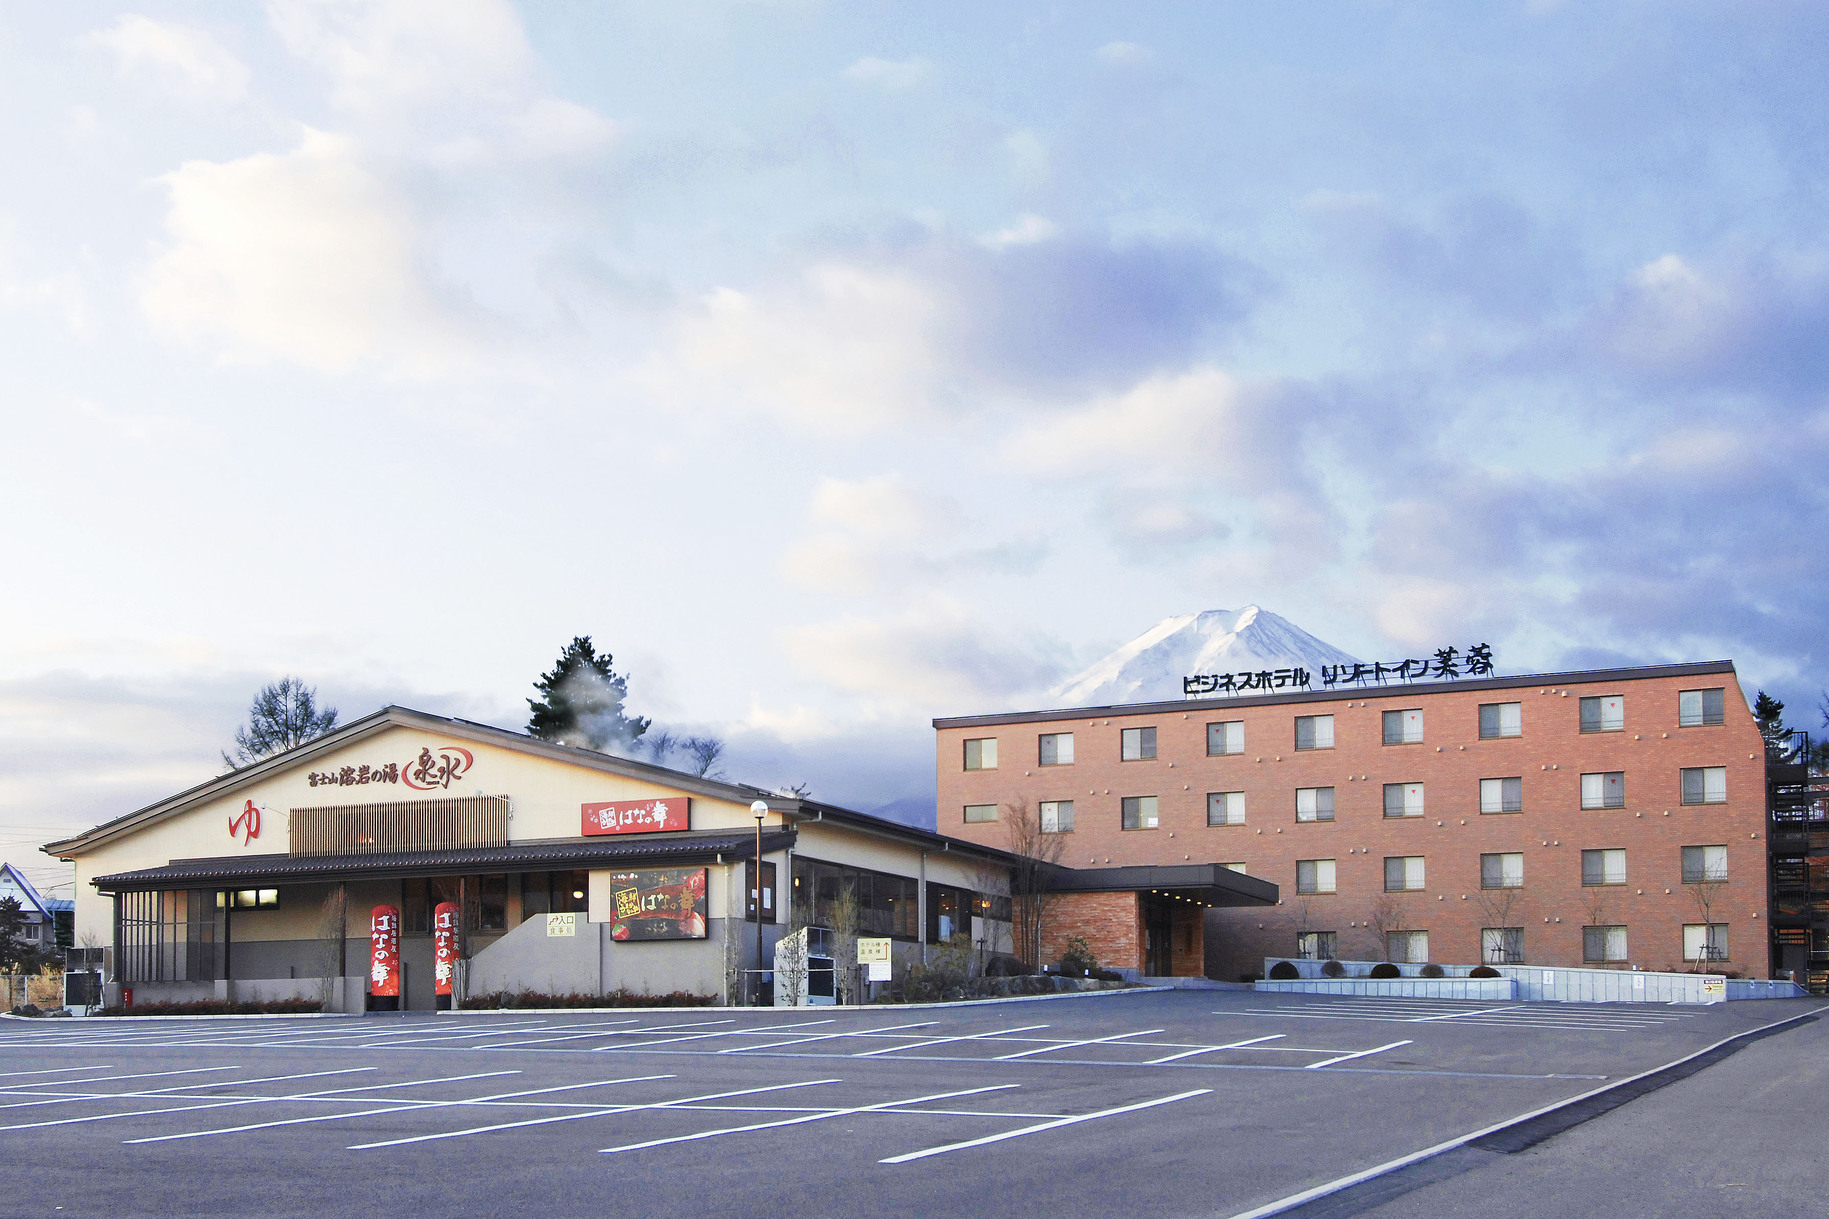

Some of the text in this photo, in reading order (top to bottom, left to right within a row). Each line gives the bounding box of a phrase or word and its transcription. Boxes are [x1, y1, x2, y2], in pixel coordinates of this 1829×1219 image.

[1184, 667, 1311, 694] ビジネスホテル
[308, 763, 398, 787] 富士山溶岩の湯
[413, 747, 461, 789] 泉水
[228, 799, 261, 847] ゆ
[619, 800, 668, 828] はなの舞
[641, 887, 695, 918] はなの舞
[558, 915, 574, 924] 入口
[371, 915, 391, 987] はなの舞
[434, 912, 453, 986] はなの舞
